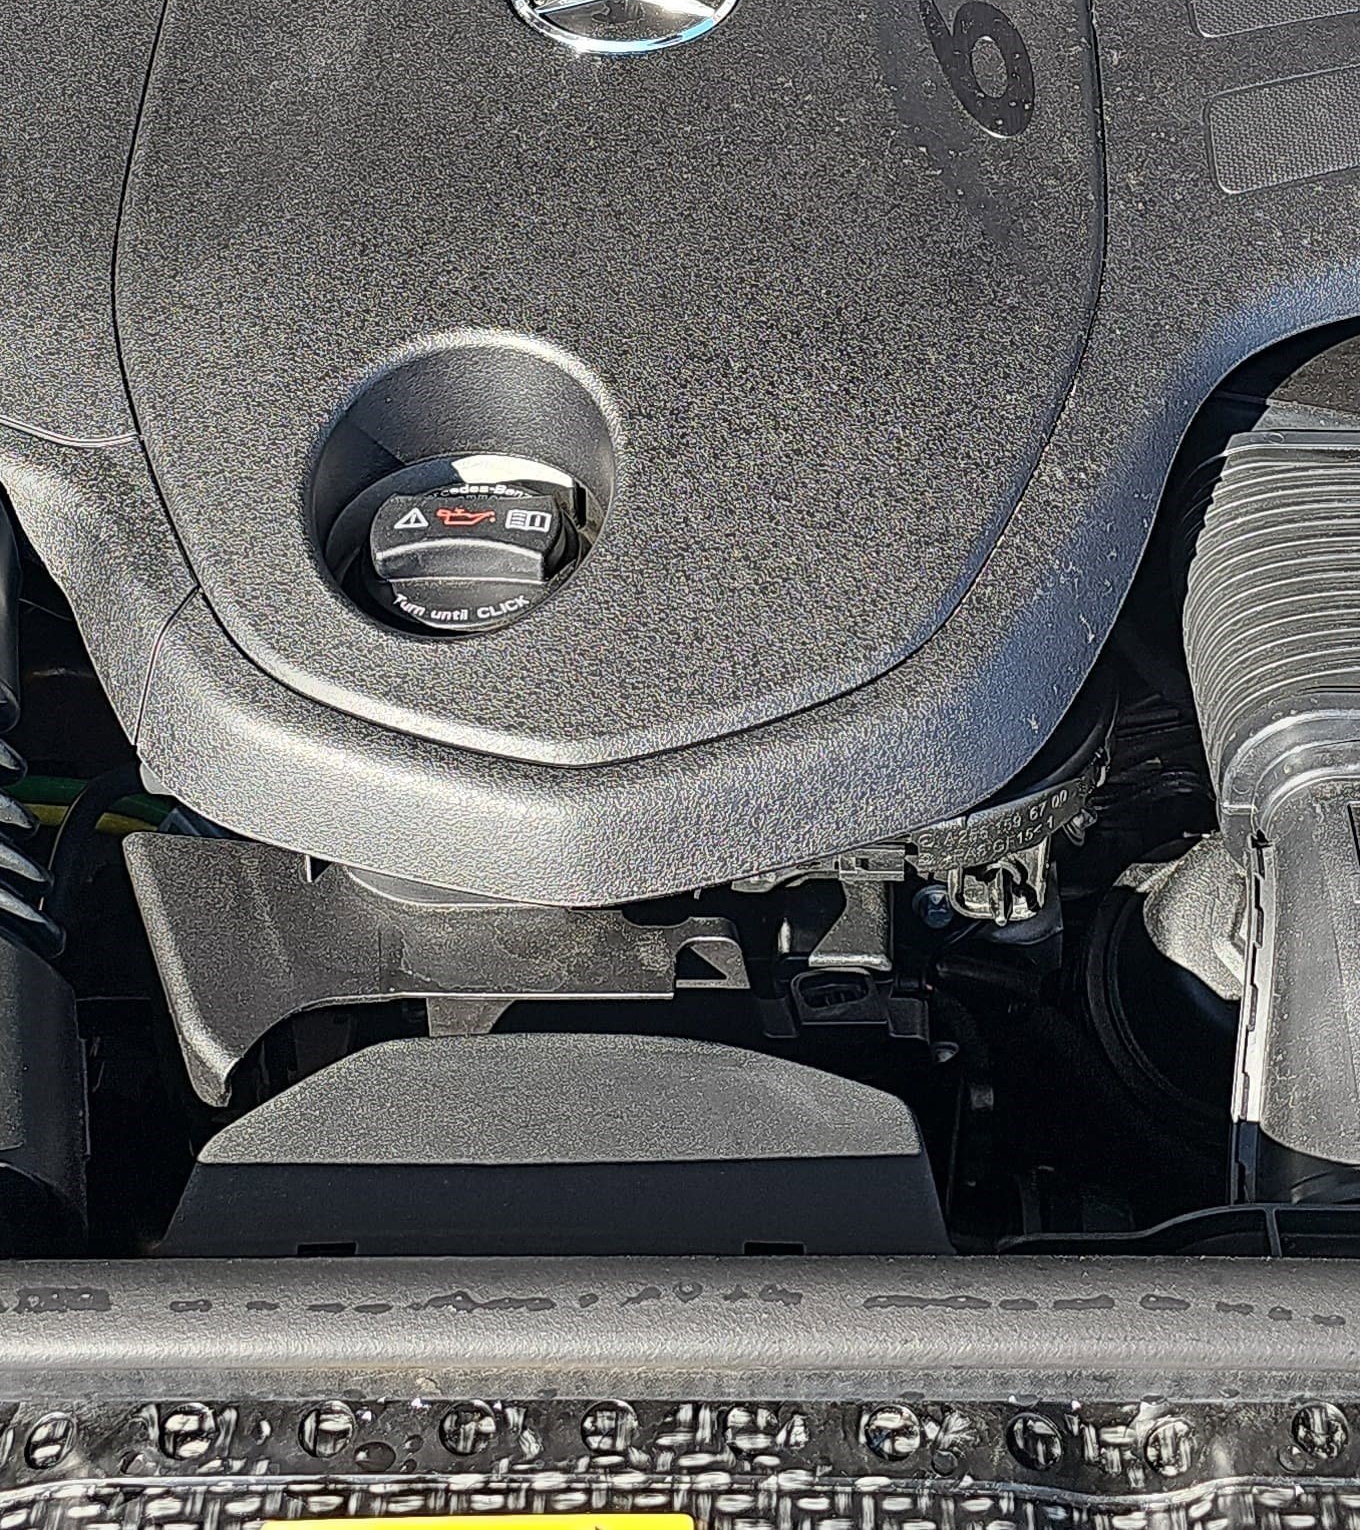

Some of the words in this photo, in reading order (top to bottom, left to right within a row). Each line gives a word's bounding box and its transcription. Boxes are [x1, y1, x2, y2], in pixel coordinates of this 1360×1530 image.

[393, 593, 426, 617] Turn
[430, 609, 468, 621] until
[476, 594, 530, 619] CLICK
[1029, 800, 1048, 820] 67
